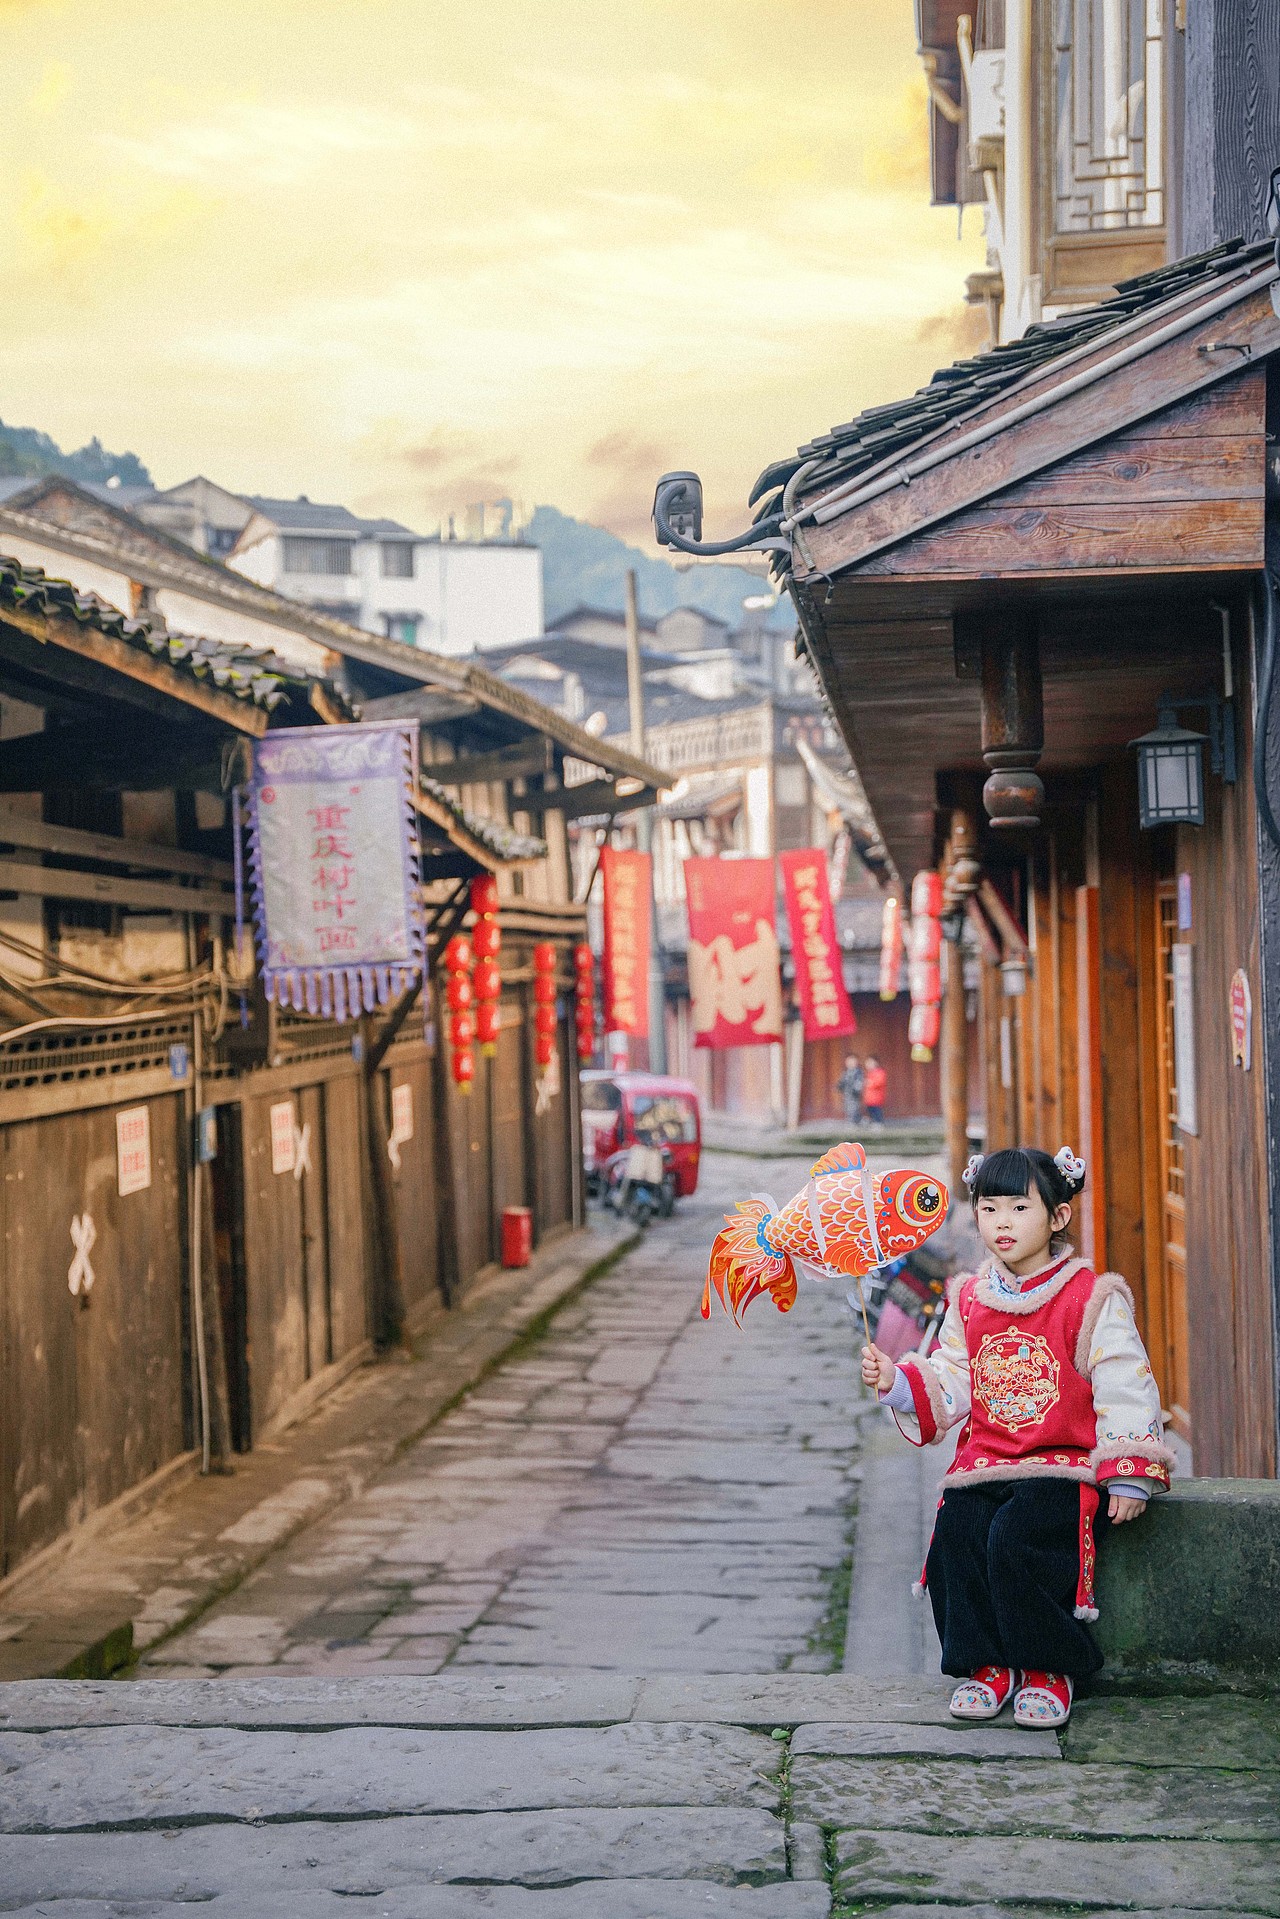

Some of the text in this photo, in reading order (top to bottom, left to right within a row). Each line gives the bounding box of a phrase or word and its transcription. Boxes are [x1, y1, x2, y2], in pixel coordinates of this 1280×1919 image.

[308, 804, 357, 951] 重庆树叶画
